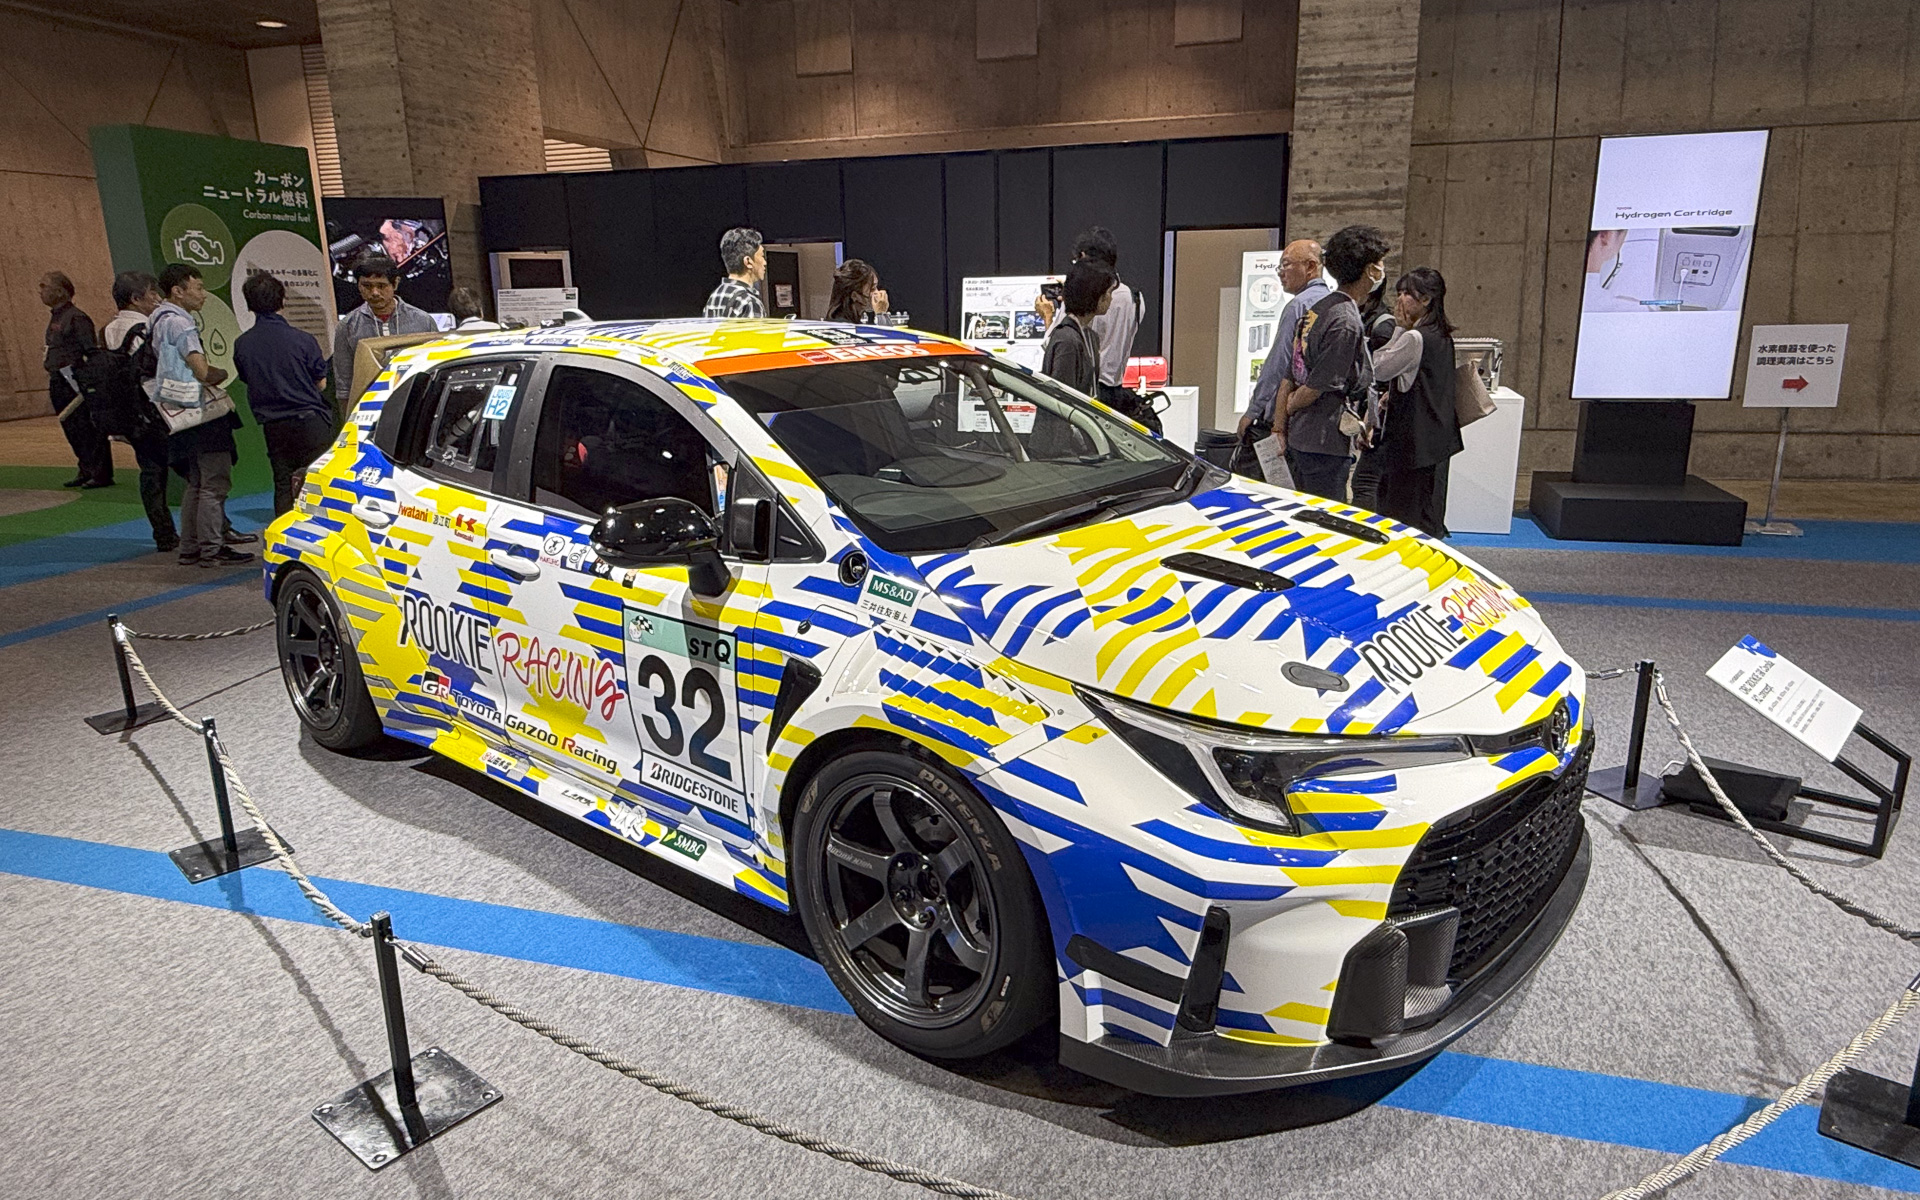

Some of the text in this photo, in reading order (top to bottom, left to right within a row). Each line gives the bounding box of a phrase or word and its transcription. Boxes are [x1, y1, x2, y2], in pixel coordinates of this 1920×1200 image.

[254, 169, 305, 188] カーボン
[203, 185, 309, 209] ニュートラル燃料
[243, 208, 311, 223] Carbon neutral fuel
[1615, 209, 1733, 219] Hydrogen Cartridge
[1255, 263, 1277, 271] Hydr
[824, 345, 930, 360] ENEOS
[1758, 344, 1836, 353] 水素機器を使った
[1756, 356, 1834, 366] 調理実演はこちら
[486, 399, 509, 416] H2
[398, 501, 428, 523] Iwatani
[872, 580, 914, 602] MS&AD
[860, 600, 908, 623] 三井住友海上
[1359, 578, 1518, 695] ROOKIE RACING
[400, 595, 625, 721] ROOKIE RACING
[423, 682, 449, 699] GR
[638, 654, 733, 781] 32
[452, 690, 617, 774] TOYOTA GAZOO Racing
[650, 763, 739, 813] BRIDGESTONE
[918, 769, 1002, 871] POTENZA
[673, 834, 706, 856] SMBC
